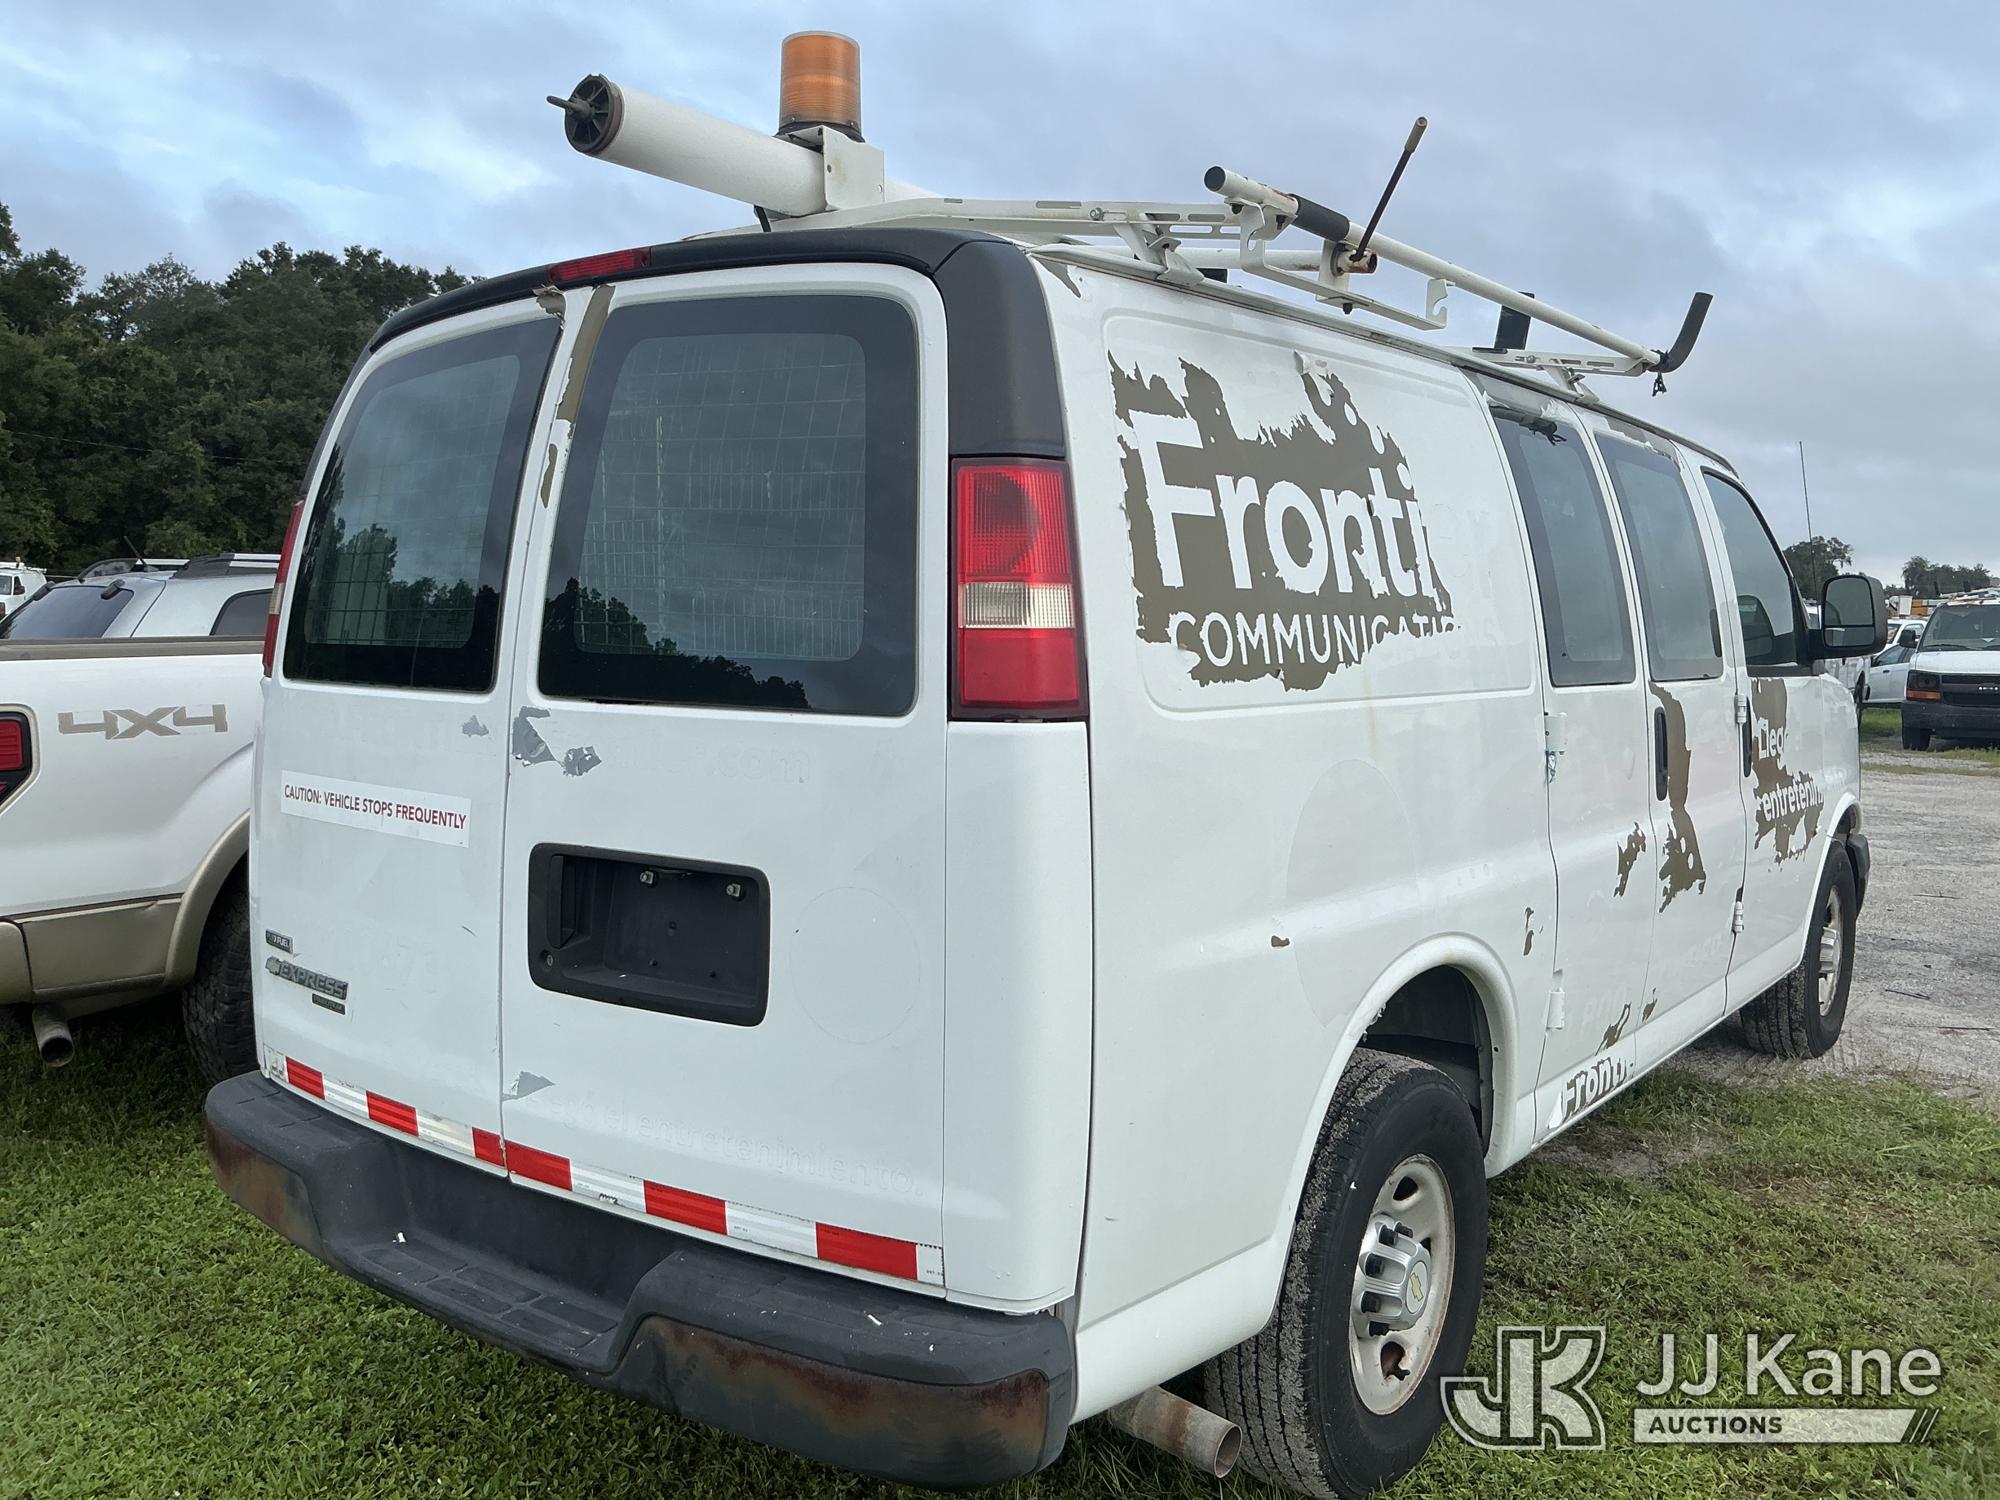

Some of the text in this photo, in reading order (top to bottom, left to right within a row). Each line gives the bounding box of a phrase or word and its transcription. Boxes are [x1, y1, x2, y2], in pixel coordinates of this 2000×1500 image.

[284, 784, 466, 830] CAUTION: VEHICLE STOPS FREQUENTLY
[280, 958, 346, 997] EXPRESS
